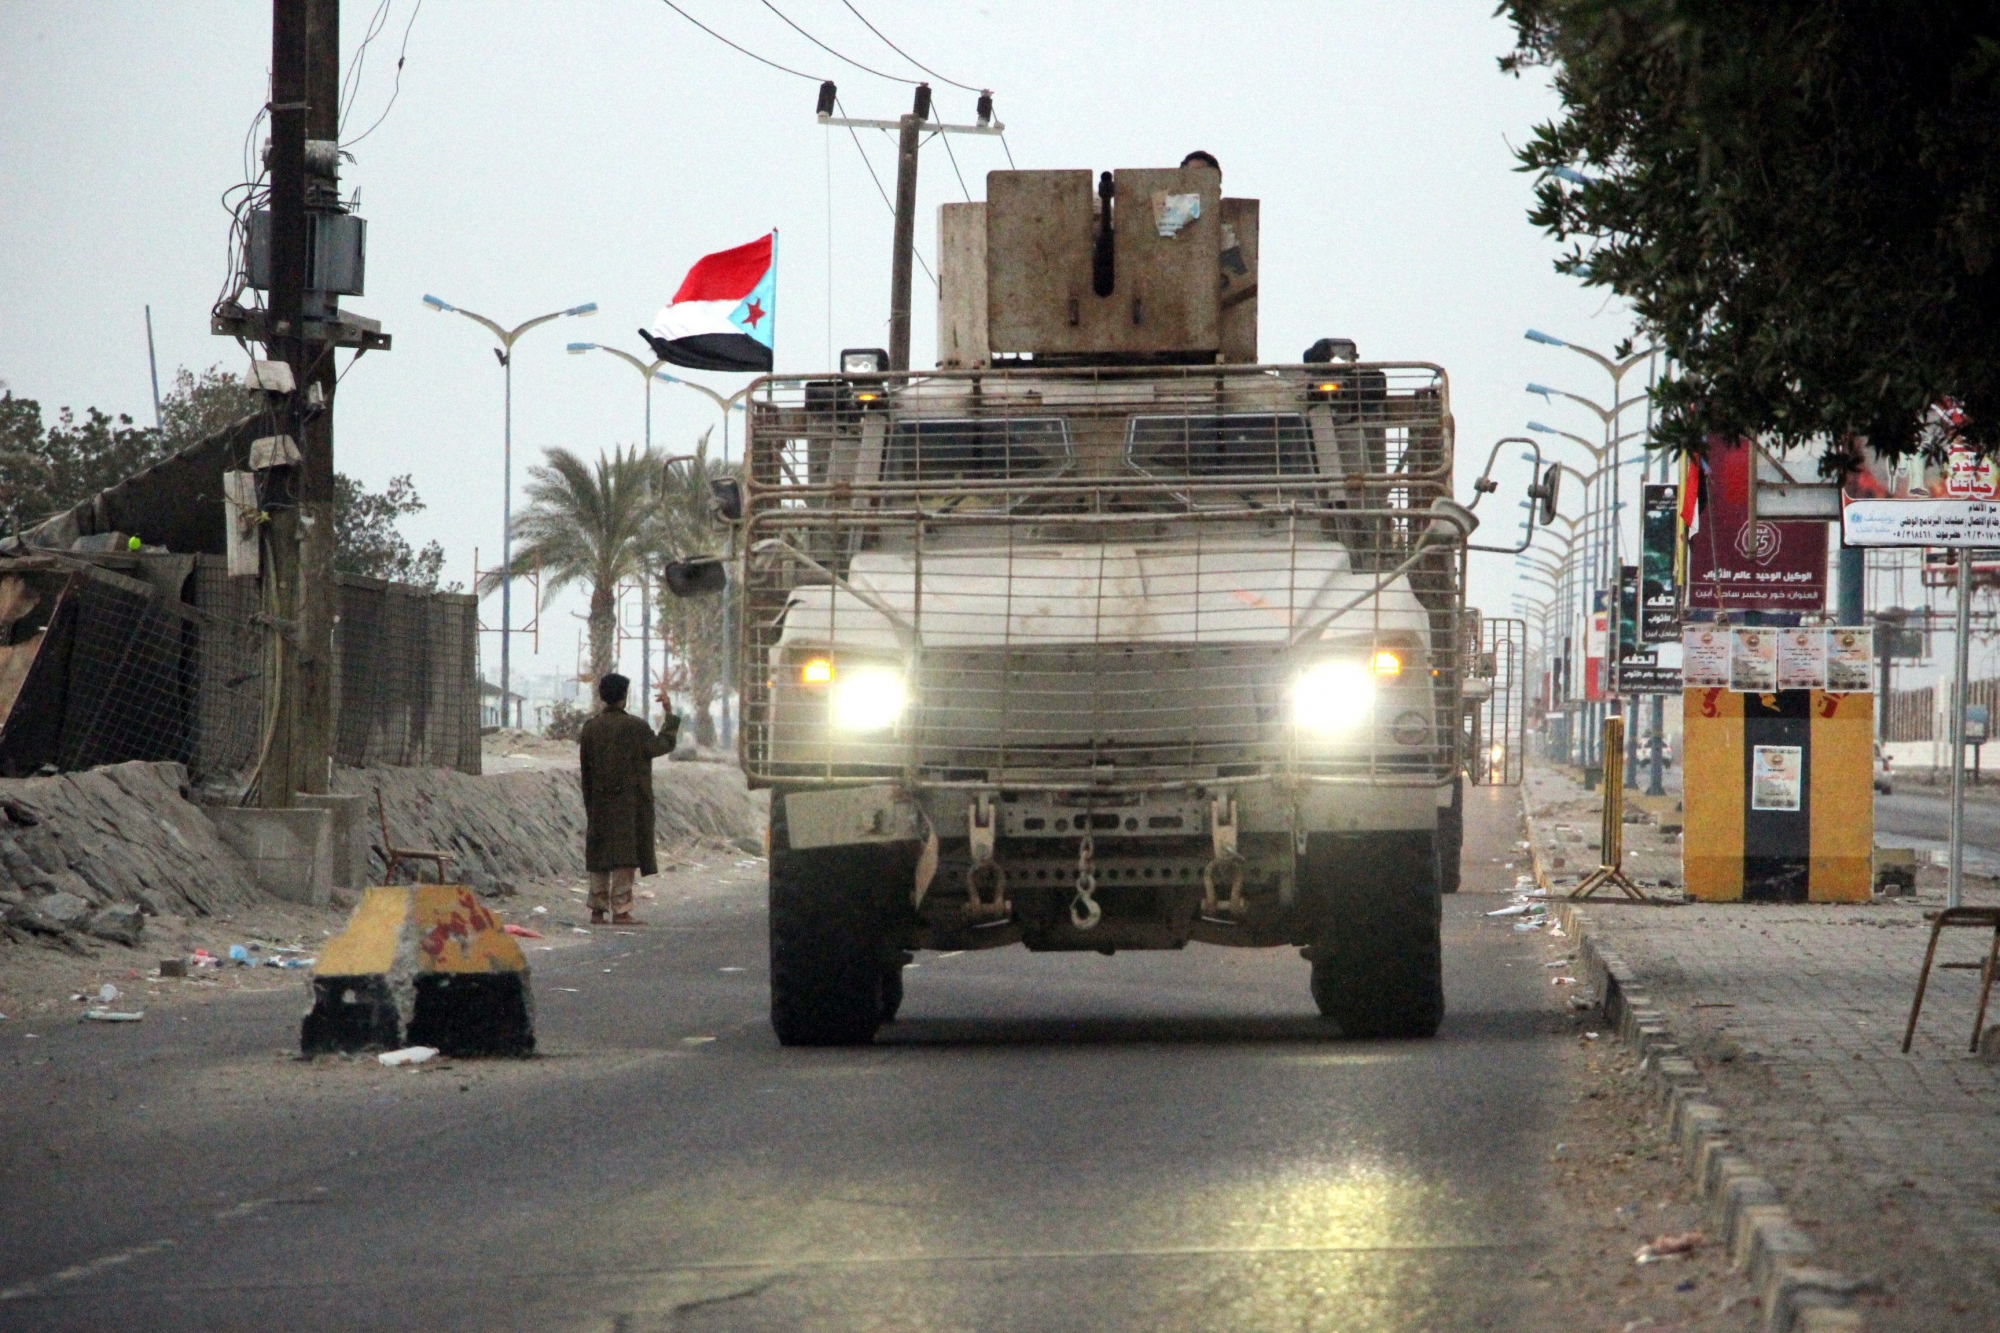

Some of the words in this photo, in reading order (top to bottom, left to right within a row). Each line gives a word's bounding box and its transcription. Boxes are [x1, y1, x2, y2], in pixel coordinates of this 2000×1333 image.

[1950, 479, 1992, 496] حياتنا
[1733, 570, 1751, 581] عالم
[1755, 571, 1781, 582] الوحيد
[1783, 571, 1812, 582] الوكيل
[1741, 590, 1767, 599] مكسر
[1769, 590, 1785, 600] خور
